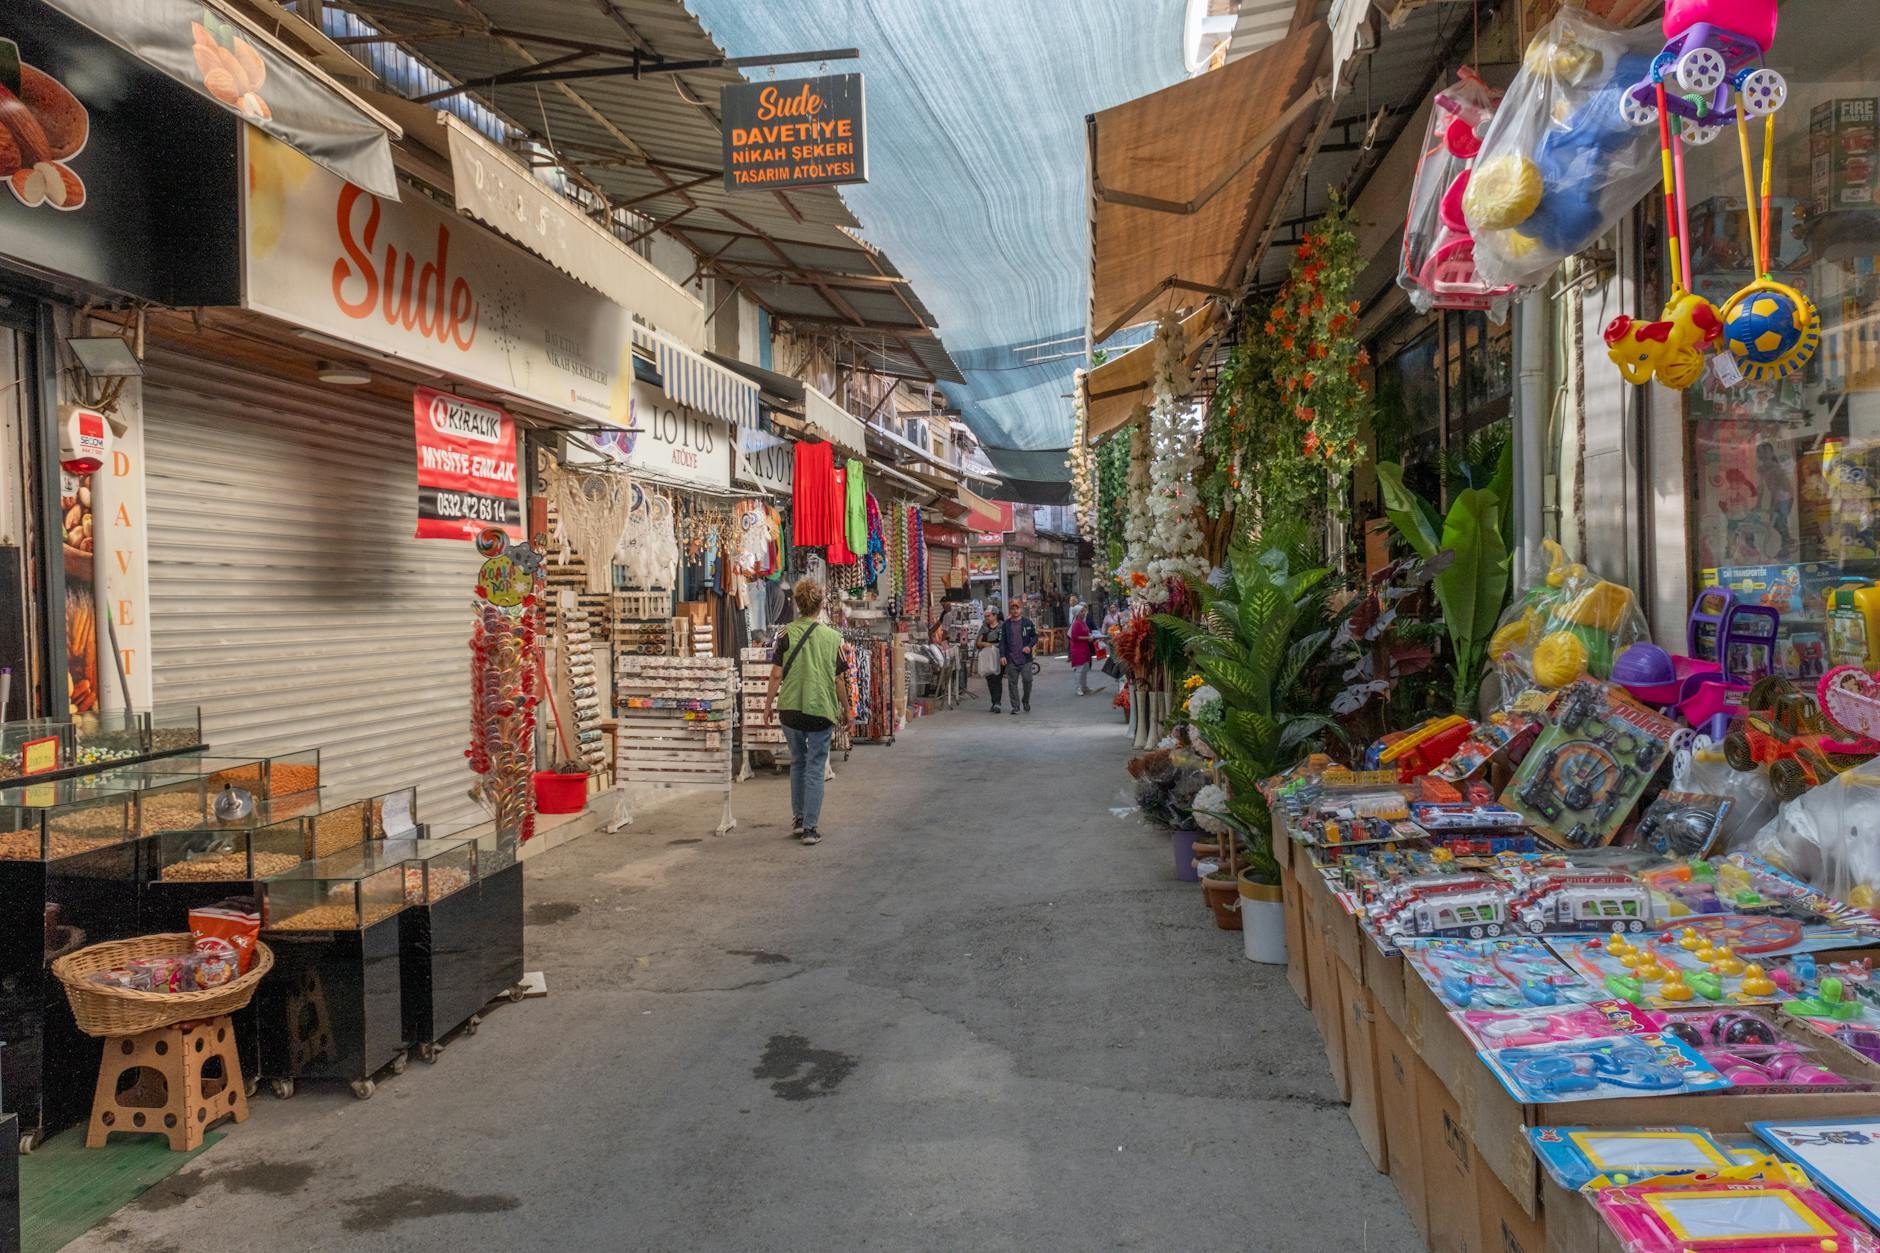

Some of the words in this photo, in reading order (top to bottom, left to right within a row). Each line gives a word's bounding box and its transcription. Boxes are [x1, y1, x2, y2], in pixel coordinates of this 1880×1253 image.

[758, 83, 823, 121] Sude
[1841, 101, 1873, 115] FIRE
[732, 119, 852, 146] DAVETİYE
[732, 146, 786, 164] NİKAH
[792, 139, 854, 161] ŞEKERİ
[733, 167, 790, 184] TASARIM
[332, 181, 480, 352] Sude
[449, 404, 499, 439] KİRALIK
[652, 404, 714, 454] LOTUS
[80, 436, 104, 446] SECOM
[422, 446, 469, 475] MYSİTE
[471, 456, 515, 482] EMLAK
[437, 492, 462, 517] 0532
[479, 498, 492, 520] 63
[494, 500, 506, 522] 14
